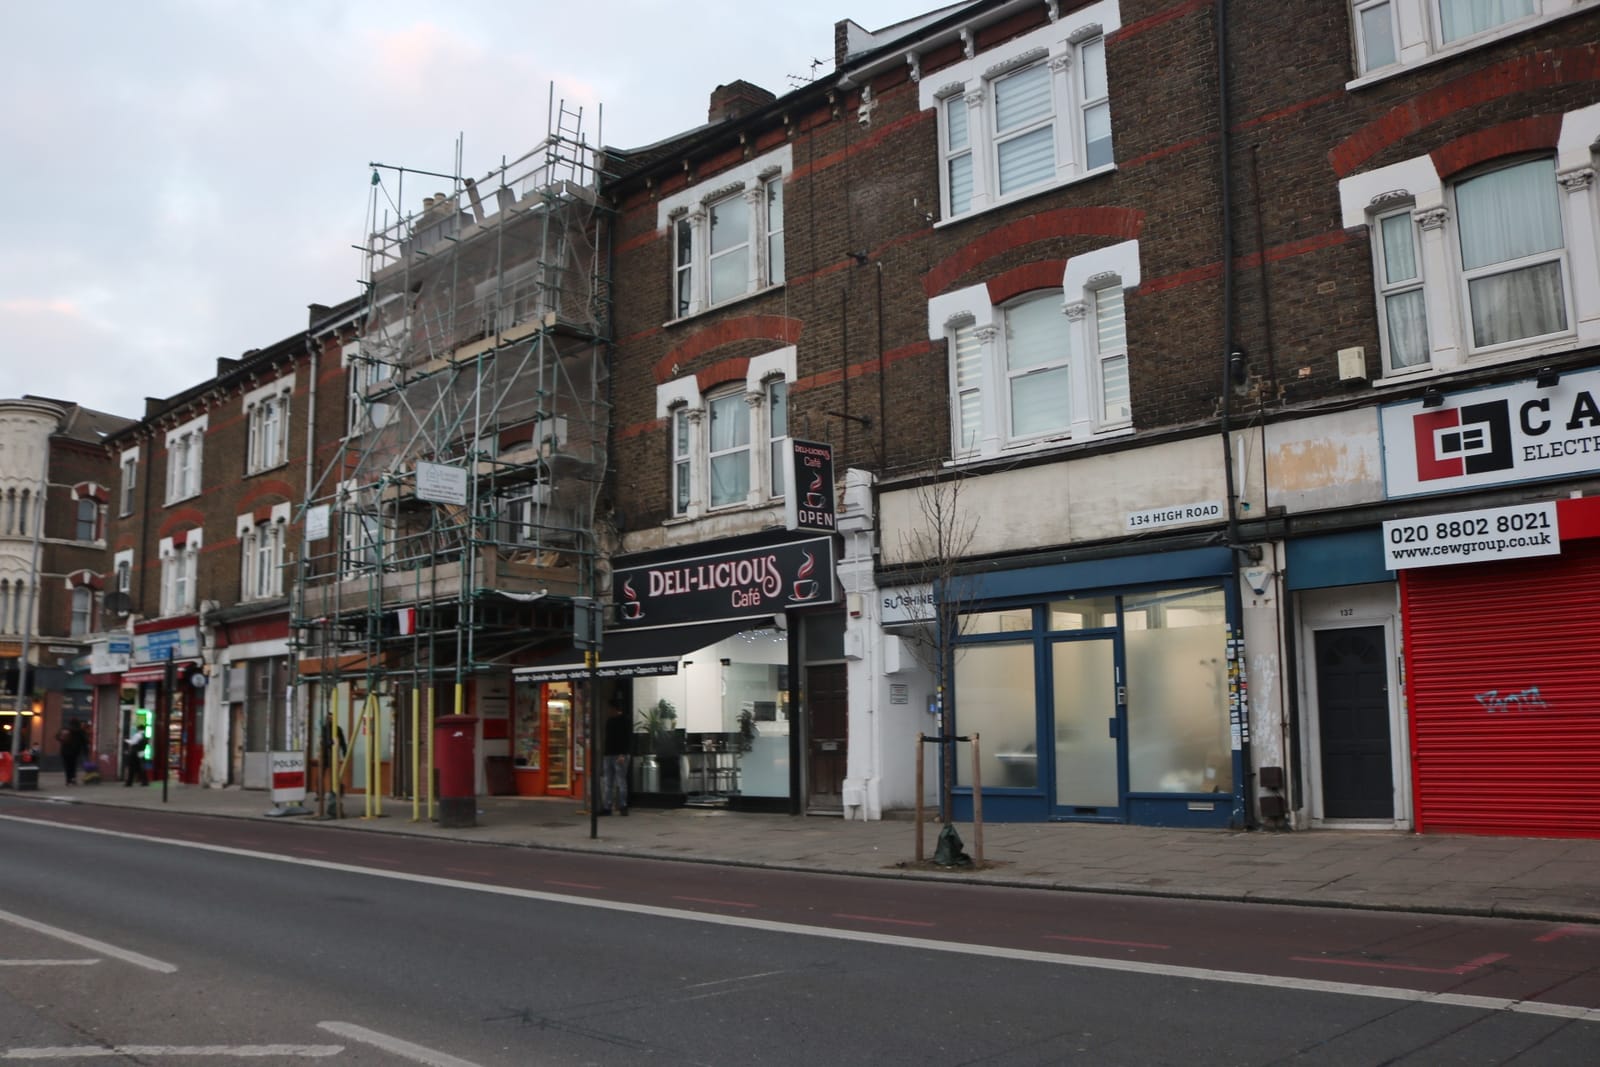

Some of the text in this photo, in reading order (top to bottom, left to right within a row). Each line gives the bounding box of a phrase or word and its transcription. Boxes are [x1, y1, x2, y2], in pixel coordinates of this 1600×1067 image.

[799, 510, 833, 526] OPEN
[1130, 505, 1218, 526] 134 HIGH ROAD
[1391, 511, 1550, 544] 020 8802 8021
[1392, 532, 1550, 559] www.cewgroup.co.uk
[648, 555, 782, 598] DELI-LICIOUS
[732, 589, 760, 608] Café
[1340, 608, 1353, 616] 132
